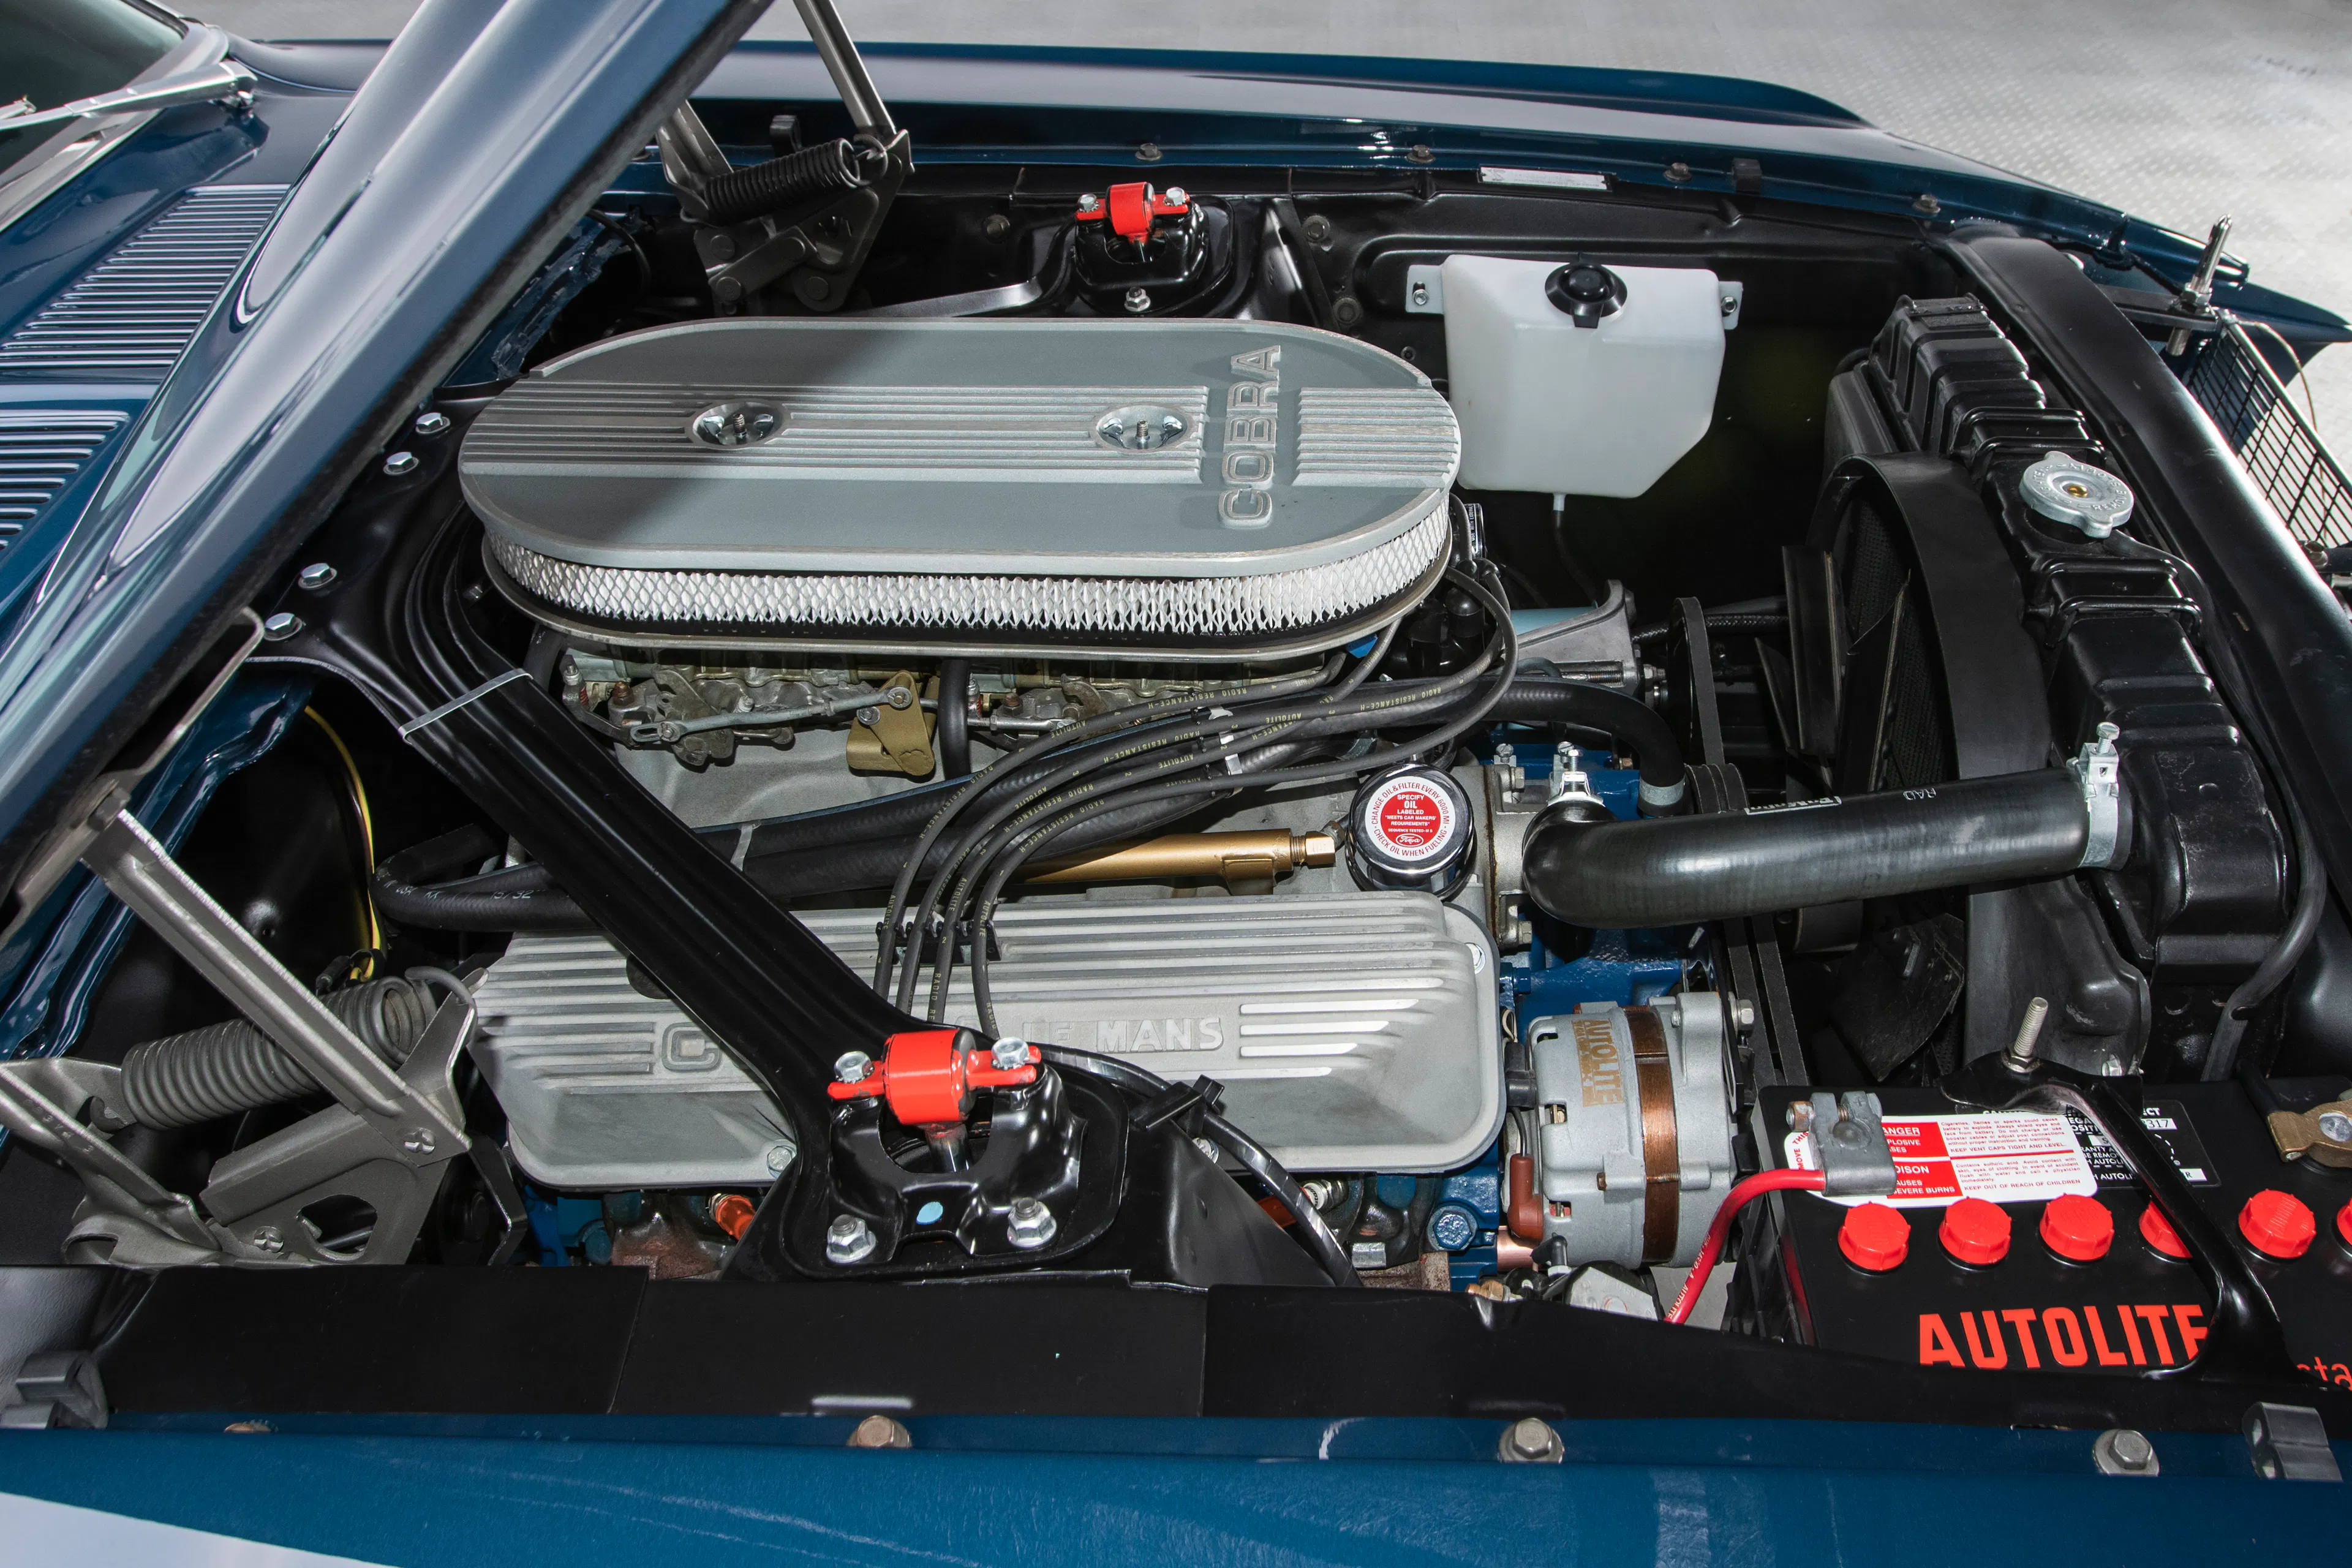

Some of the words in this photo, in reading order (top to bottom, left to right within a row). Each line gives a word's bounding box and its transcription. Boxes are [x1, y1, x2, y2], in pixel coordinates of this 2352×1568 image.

[1218, 345, 1281, 527] COBRA
[1148, 692, 1215, 709] RESISTANCE-H
[1222, 687, 1247, 697] RADIO
[1360, 694, 1416, 711] RESISTANCE-H
[1421, 687, 1441, 699] RADIO
[1265, 712, 1302, 724] AUTOLITE
[1051, 720, 1086, 738] AUTOLITE
[1103, 738, 1167, 764] RESISTANCE-H
[1158, 753, 1194, 769] AUTOLITE
[970, 765, 995, 784] RADIO
[1014, 786, 1048, 809] AUTOLITE
[1068, 783, 1094, 797] RADIO
[1421, 785, 1441, 800] EVERY
[1902, 787, 1937, 801] RAD
[919, 786, 966, 839] RESISTANCE-H
[1003, 796, 1063, 834] RESISTANCE-H
[1079, 799, 1105, 813] RADIO
[1371, 797, 1384, 824] CHANGE
[1438, 799, 1449, 815] 6000
[1442, 815, 1450, 824] MI
[1019, 812, 1074, 853] RESISTANCE-H
[1374, 829, 1390, 849] CHECK
[1390, 845, 1401, 855] OIL
[1425, 829, 1447, 852] FUELING
[949, 877, 968, 912] AUTOLITE
[883, 895, 896, 930] AUTOLITE
[979, 900, 991, 937] AUTOLITE
[932, 973, 941, 1001] RADIO
[1096, 1017, 1224, 1052] MANS
[1584, 1019, 1624, 1104] AUTOLITE
[1792, 1131, 1809, 1145] THIS
[1882, 1127, 1921, 1136] ANGER
[1793, 1148, 1804, 1169] MOVE
[1667, 1284, 1689, 1320] AUTOLITE
[1919, 1304, 2209, 1370] AUTOLITE
